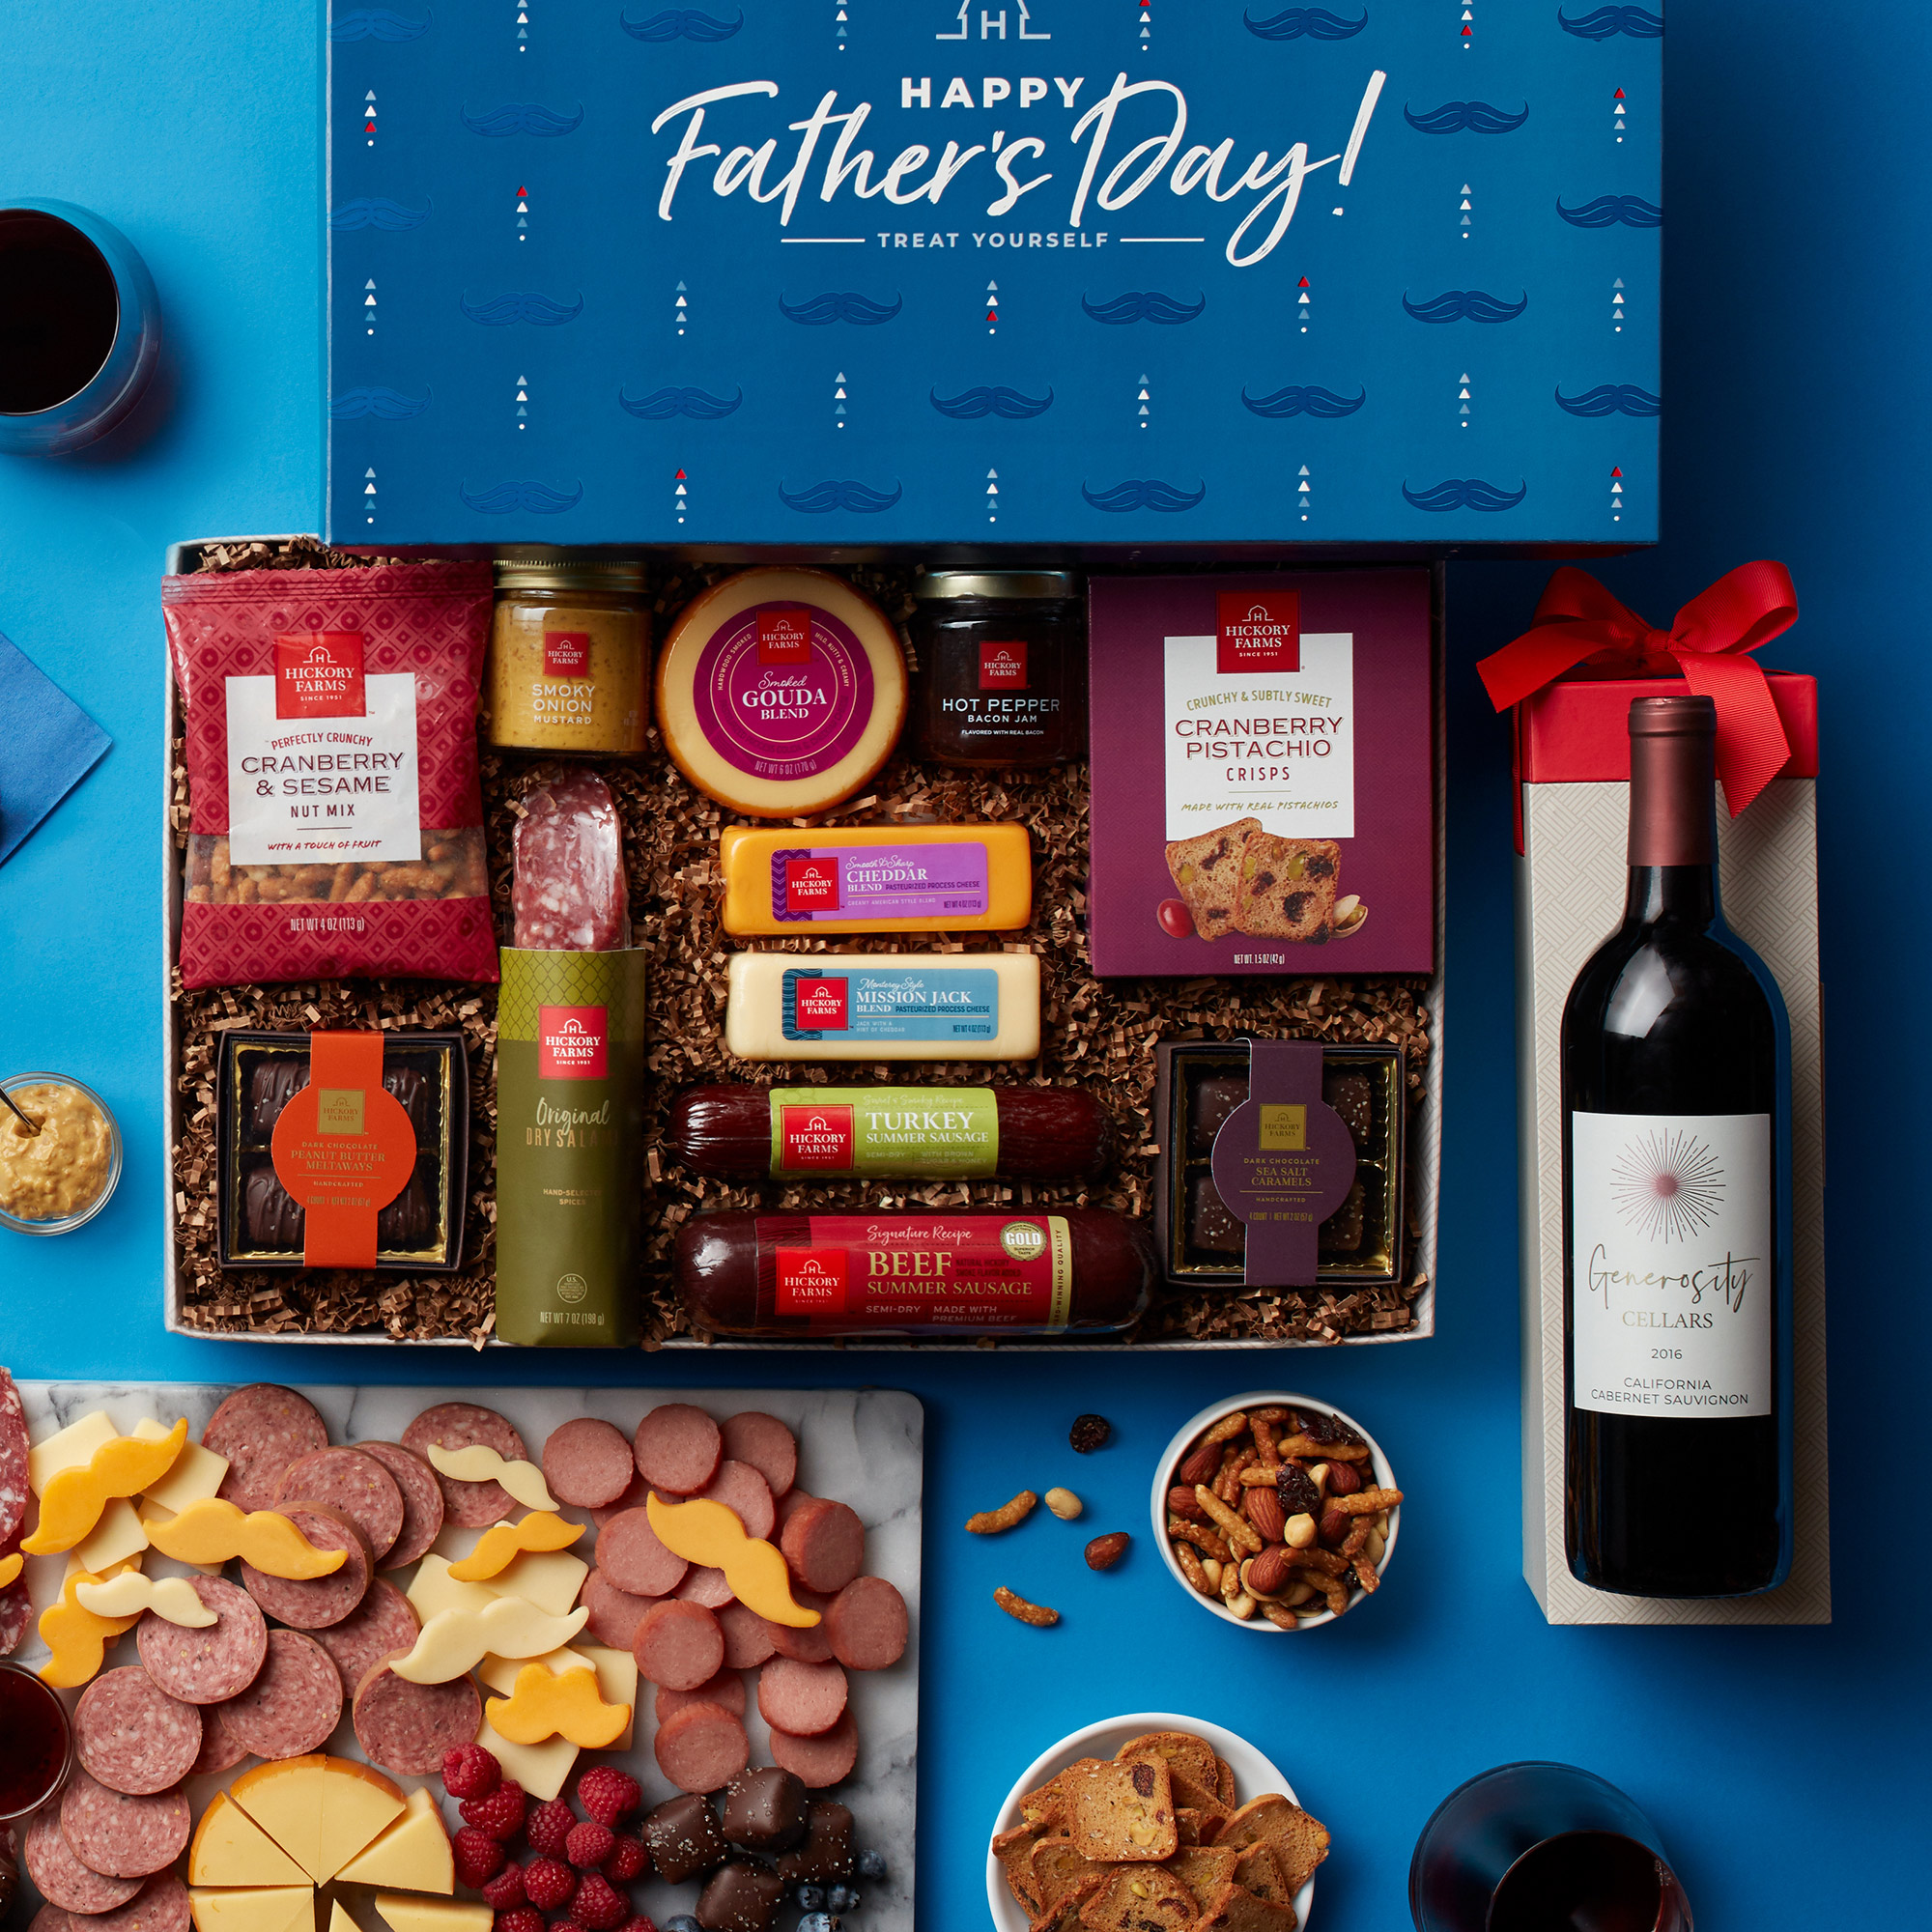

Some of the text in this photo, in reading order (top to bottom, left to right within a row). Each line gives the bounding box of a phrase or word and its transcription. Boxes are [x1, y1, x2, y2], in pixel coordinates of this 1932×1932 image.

[901, 77, 1084, 108] HAPPY
[651, 71, 1387, 267] Father's Day!
[877, 232, 1110, 248] TREAT YOURSELF
[762, 633, 805, 641] HICKORY
[1226, 625, 1291, 637] HICKORY
[1235, 638, 1282, 648] FARMS
[718, 633, 753, 691] HARDWOOD SMOKED
[285, 667, 355, 679] HICKORY
[758, 670, 808, 690] Smoked
[840, 665, 849, 687] CREAMY
[296, 680, 346, 693] FARMS
[532, 684, 595, 697] SMOKY
[742, 688, 828, 708] GOUDA
[942, 698, 1060, 712] HOT PEPPER
[1186, 690, 1332, 711] CRUNCHY & SUBTLY SWEET
[533, 699, 592, 712] ONION
[533, 716, 592, 724] MUSTARD
[760, 708, 810, 720] BLEND
[1176, 717, 1345, 737] CRANBERRY
[271, 732, 373, 750] PERFECTLY CRUNCHY
[1186, 739, 1332, 759] PISTACHIO
[242, 752, 405, 774] CRANBERRY
[754, 760, 767, 773] NET
[768, 763, 778, 774] WT
[779, 764, 784, 775] 6
[784, 764, 793, 775] OZ
[1226, 767, 1291, 781] CRISPS
[256, 776, 391, 797] & SESAME
[291, 804, 355, 818] NUT MIX
[1181, 803, 1212, 811] MADE
[1247, 802, 1275, 810] REAL
[1277, 801, 1339, 810] PISTACHIOS
[268, 842, 293, 851] WITH
[337, 840, 350, 849] OF
[845, 856, 878, 870] Smooth
[888, 855, 915, 869] Sharp
[846, 867, 928, 883] CHEDDAR
[791, 879, 833, 888] HICKORY
[847, 883, 882, 893] BLEND
[291, 918, 304, 931] NET
[306, 918, 319, 930] WT
[320, 918, 326, 930] 4
[327, 918, 337, 930] OZ
[339, 917, 355, 931] (113
[857, 976, 924, 995] Monterey Style
[801, 999, 842, 1008] HICKORY
[856, 991, 973, 1006] MISSION JACK
[807, 1007, 838, 1015] FARMS
[546, 1036, 601, 1046] HICKORY
[553, 1047, 594, 1058] FARMS
[536, 1096, 611, 1136] Original
[865, 1112, 975, 1130] TURKEY
[526, 1127, 551, 1147] DRY
[789, 1133, 846, 1144] HICKORY
[866, 1132, 989, 1144] SUMMER SAUSAGE
[797, 1144, 838, 1154] FARMS
[291, 1151, 385, 1162] PEANUT BUTTER
[306, 1161, 373, 1171] MELTAWAYS
[1256, 1167, 1308, 1177] SEA SALT
[1251, 1177, 1312, 1187] CARAMELS
[867, 1225, 973, 1246] Signature Recipe
[1006, 1232, 1041, 1245] GOLD
[1055, 1230, 1064, 1265] QUALITY
[867, 1251, 953, 1277] BEEF
[784, 1276, 840, 1288] HICKORY
[1588, 1243, 1761, 1313] Generosity
[792, 1287, 833, 1297] FARMS
[867, 1281, 1033, 1295] SUMMER SAUSAGE
[866, 1305, 922, 1314] SEMI-DRY
[540, 1312, 552, 1323] NET
[554, 1313, 564, 1324] WT
[565, 1313, 570, 1324] 7
[572, 1313, 581, 1324] OZ
[1622, 1310, 1714, 1329] CELLARS
[1651, 1349, 1683, 1360] 2016
[1624, 1377, 1712, 1390] CALIFORNIA
[1591, 1388, 1748, 1406] CABERNET SAUVIGNON
